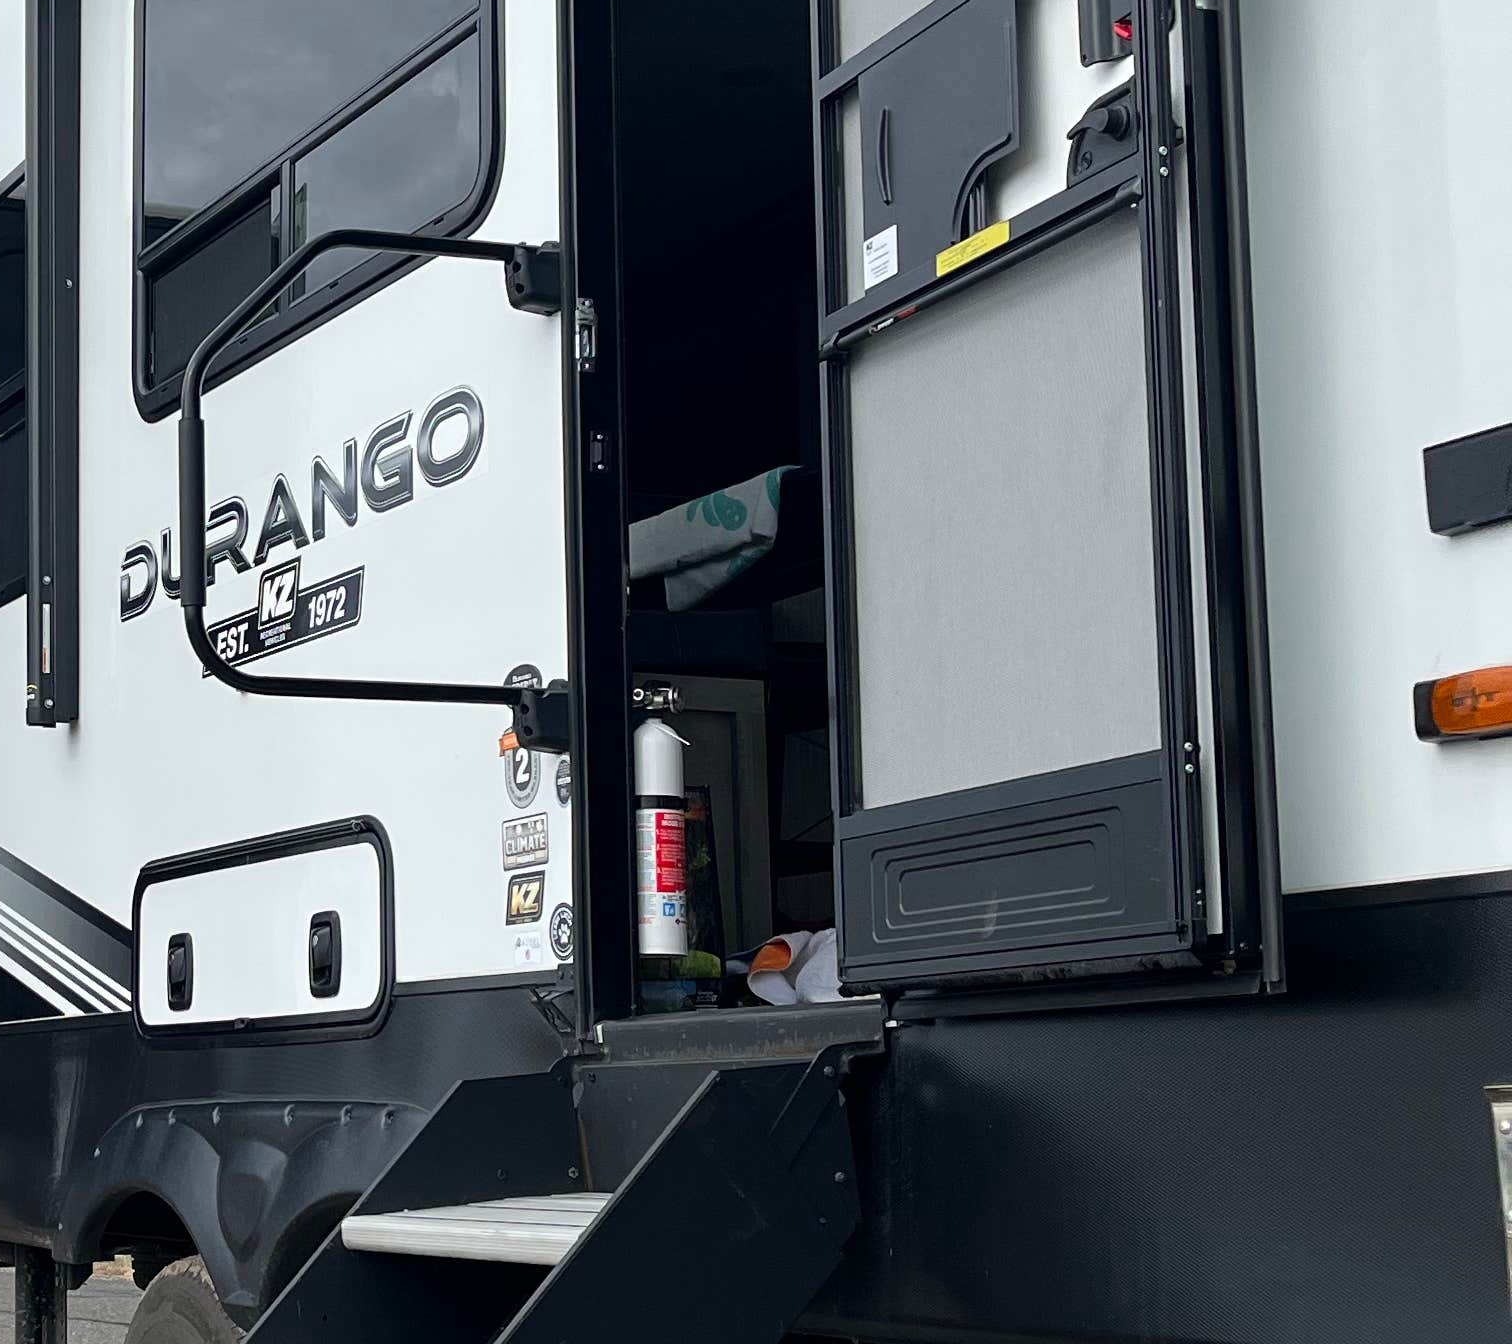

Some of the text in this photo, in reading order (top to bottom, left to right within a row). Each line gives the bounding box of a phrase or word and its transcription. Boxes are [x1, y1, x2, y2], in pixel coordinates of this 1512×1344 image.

[120, 384, 485, 623] DURANGO
[261, 570, 295, 622] KZ
[217, 622, 249, 660] EST.
[308, 585, 347, 629] 1972
[515, 747, 530, 784] 2
[505, 831, 547, 856] CLIMATE
[511, 881, 540, 916] KZ
